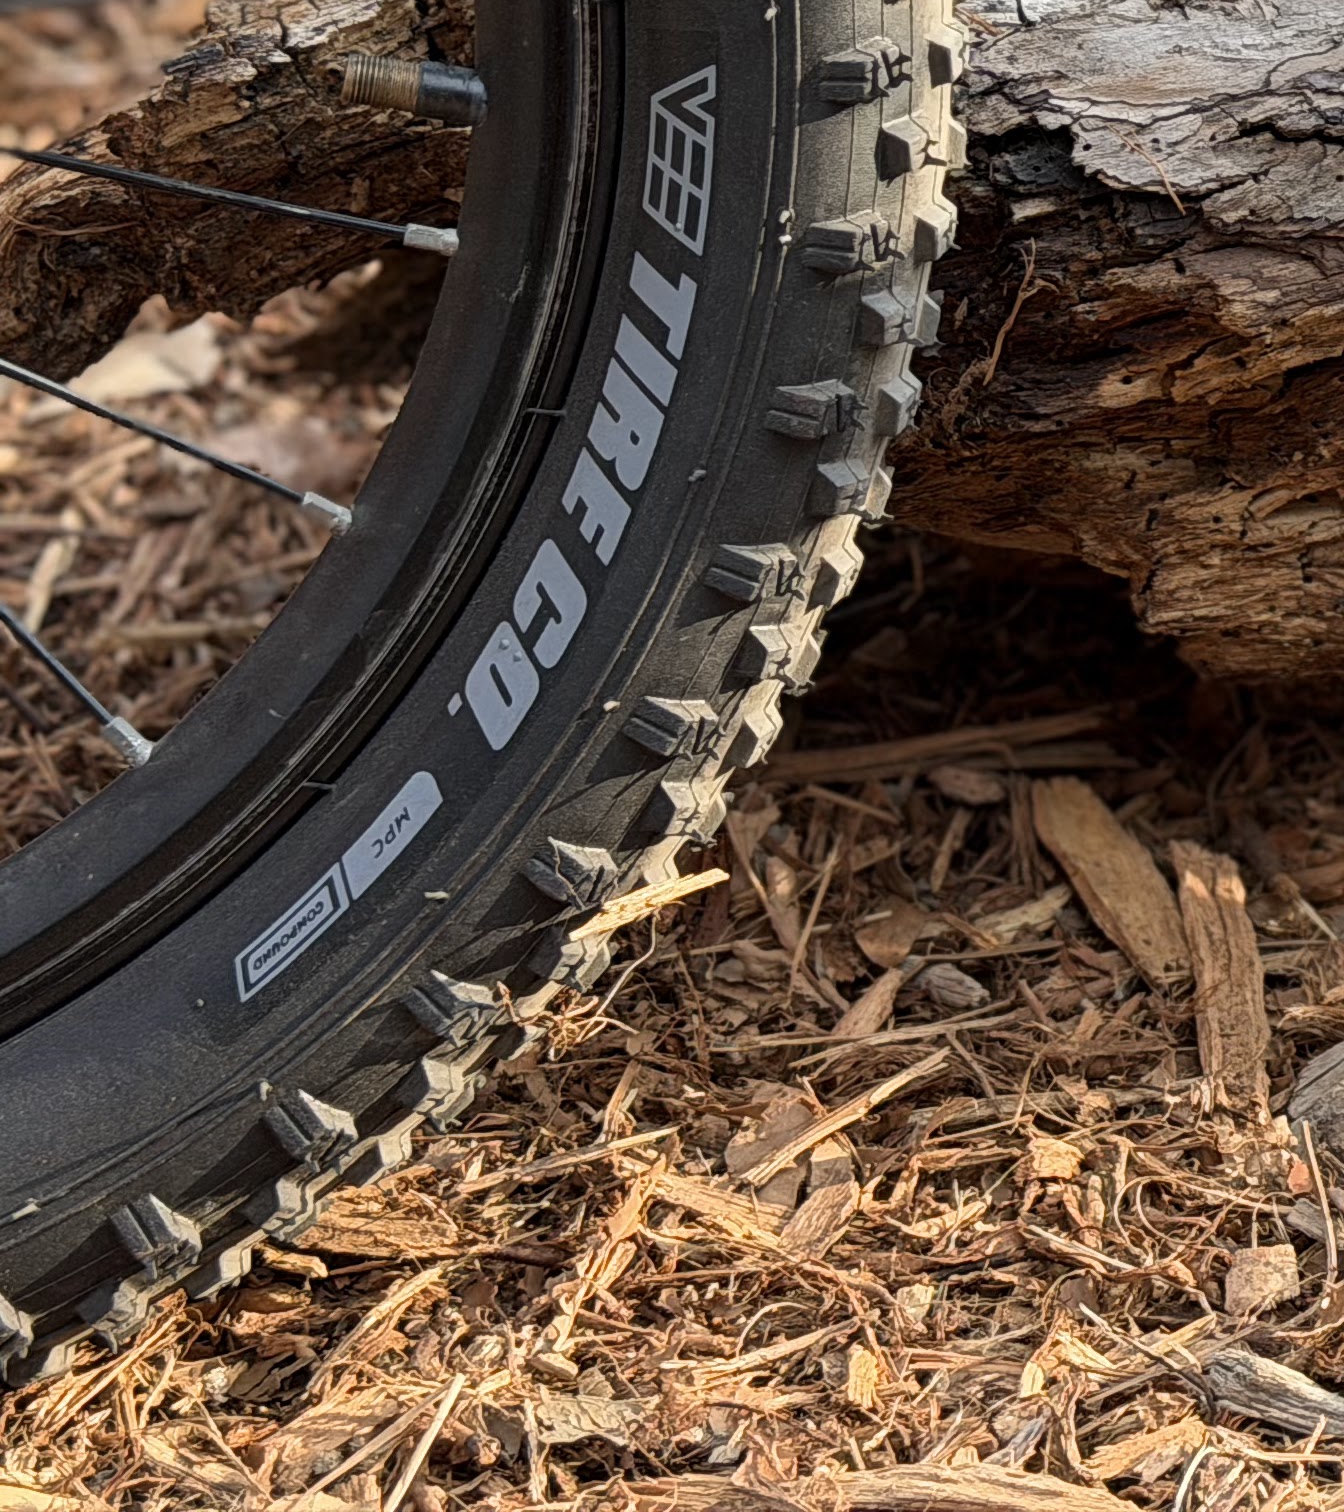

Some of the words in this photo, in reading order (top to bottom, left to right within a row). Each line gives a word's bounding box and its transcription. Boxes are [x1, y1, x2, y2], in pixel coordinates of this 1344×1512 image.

[562, 251, 697, 566] TIRE
[448, 538, 588, 751] CO.
[370, 806, 411, 860] MPC
[252, 899, 325, 972] COMPOUND
